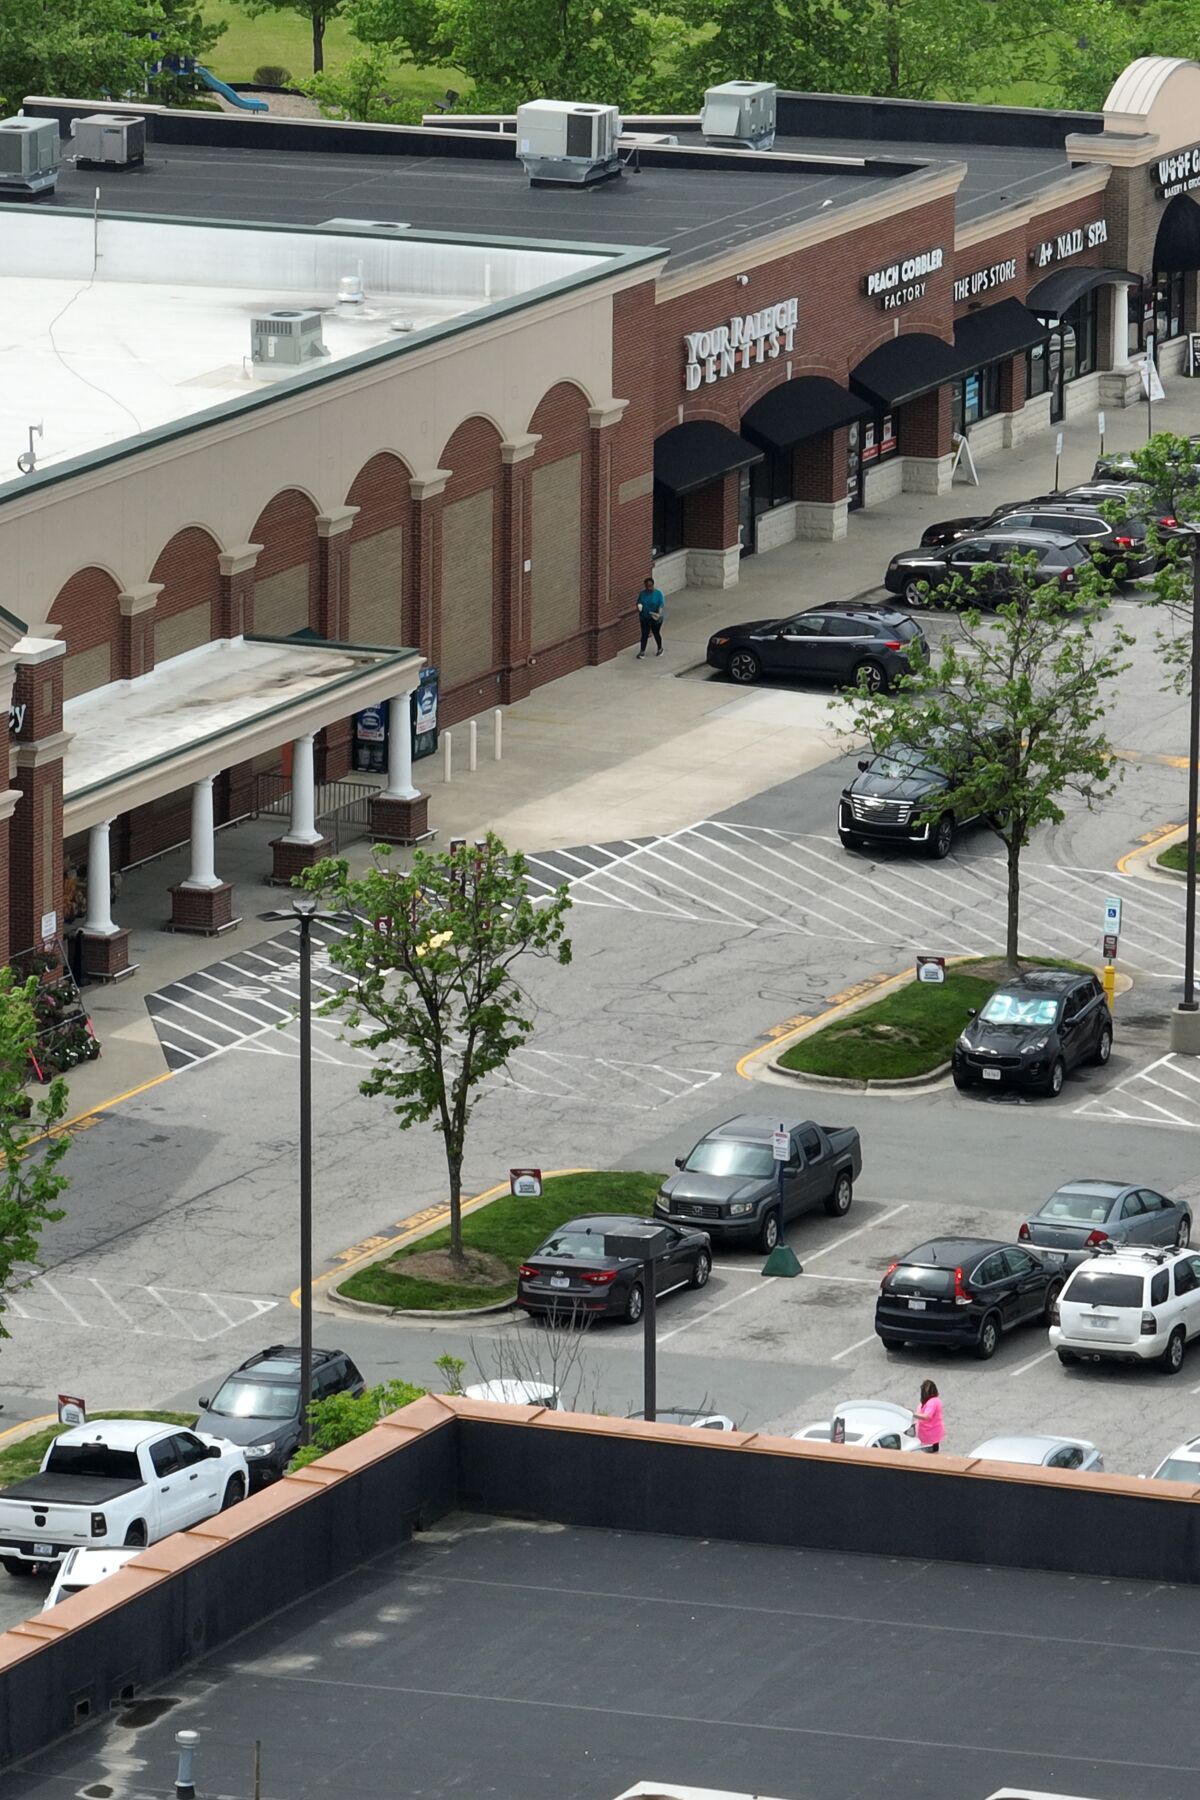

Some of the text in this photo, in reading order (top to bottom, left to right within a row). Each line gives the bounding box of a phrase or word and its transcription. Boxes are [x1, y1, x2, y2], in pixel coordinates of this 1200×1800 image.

[1038, 219, 1108, 268] A+ NAIL SPA
[868, 248, 943, 296] PEACH COBBLER
[884, 282, 926, 310] FACTORY
[953, 258, 1017, 302] THE UPS STORE
[684, 297, 799, 364] YOUR RALEIGH
[686, 324, 797, 391] DENTIST
[222, 985, 272, 1001] NO
